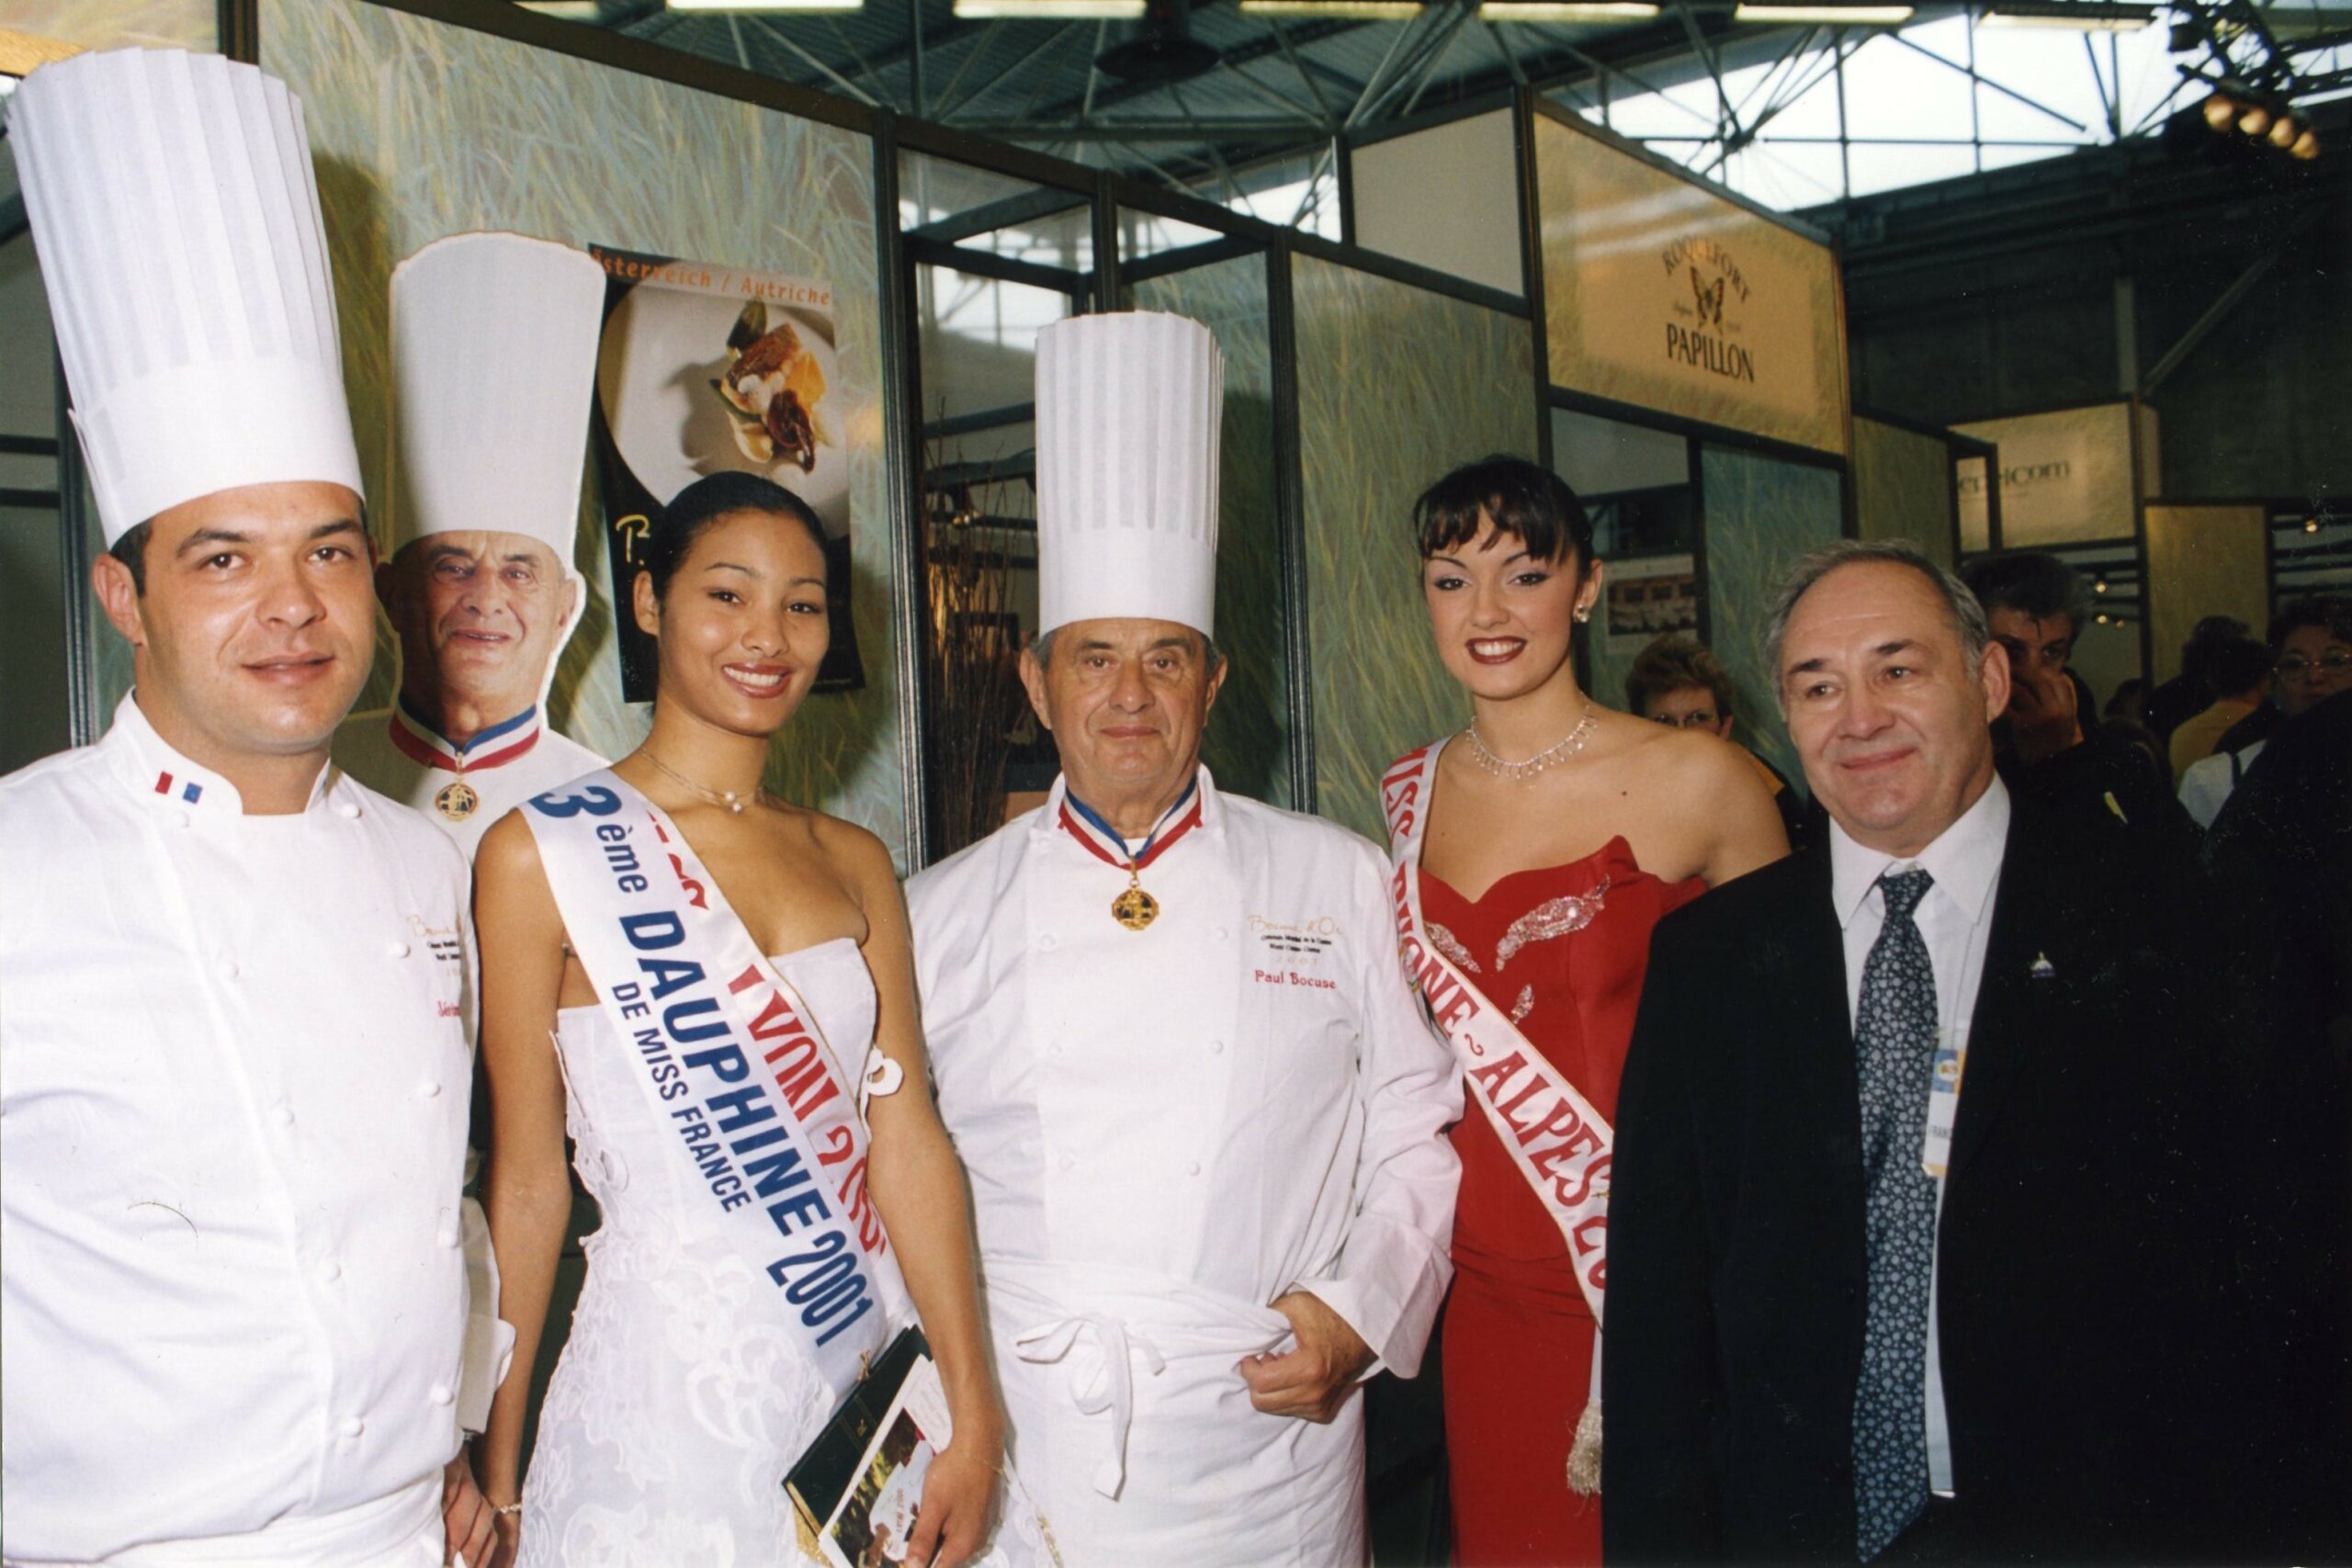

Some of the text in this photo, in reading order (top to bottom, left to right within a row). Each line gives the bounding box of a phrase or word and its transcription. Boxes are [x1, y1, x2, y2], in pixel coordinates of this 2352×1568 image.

[741, 276, 831, 307] Autriche
[1662, 235, 1751, 303] ROQUEFORT
[1666, 321, 1755, 384] PAPILLON
[1253, 969, 1337, 989] Paul Bocuse
[612, 982, 752, 1214] DE MISS FRANCE
[618, 910, 832, 1236] DAUPHINE
[765, 1230, 874, 1348] 2001
[1468, 1049, 1612, 1208] ALPES
